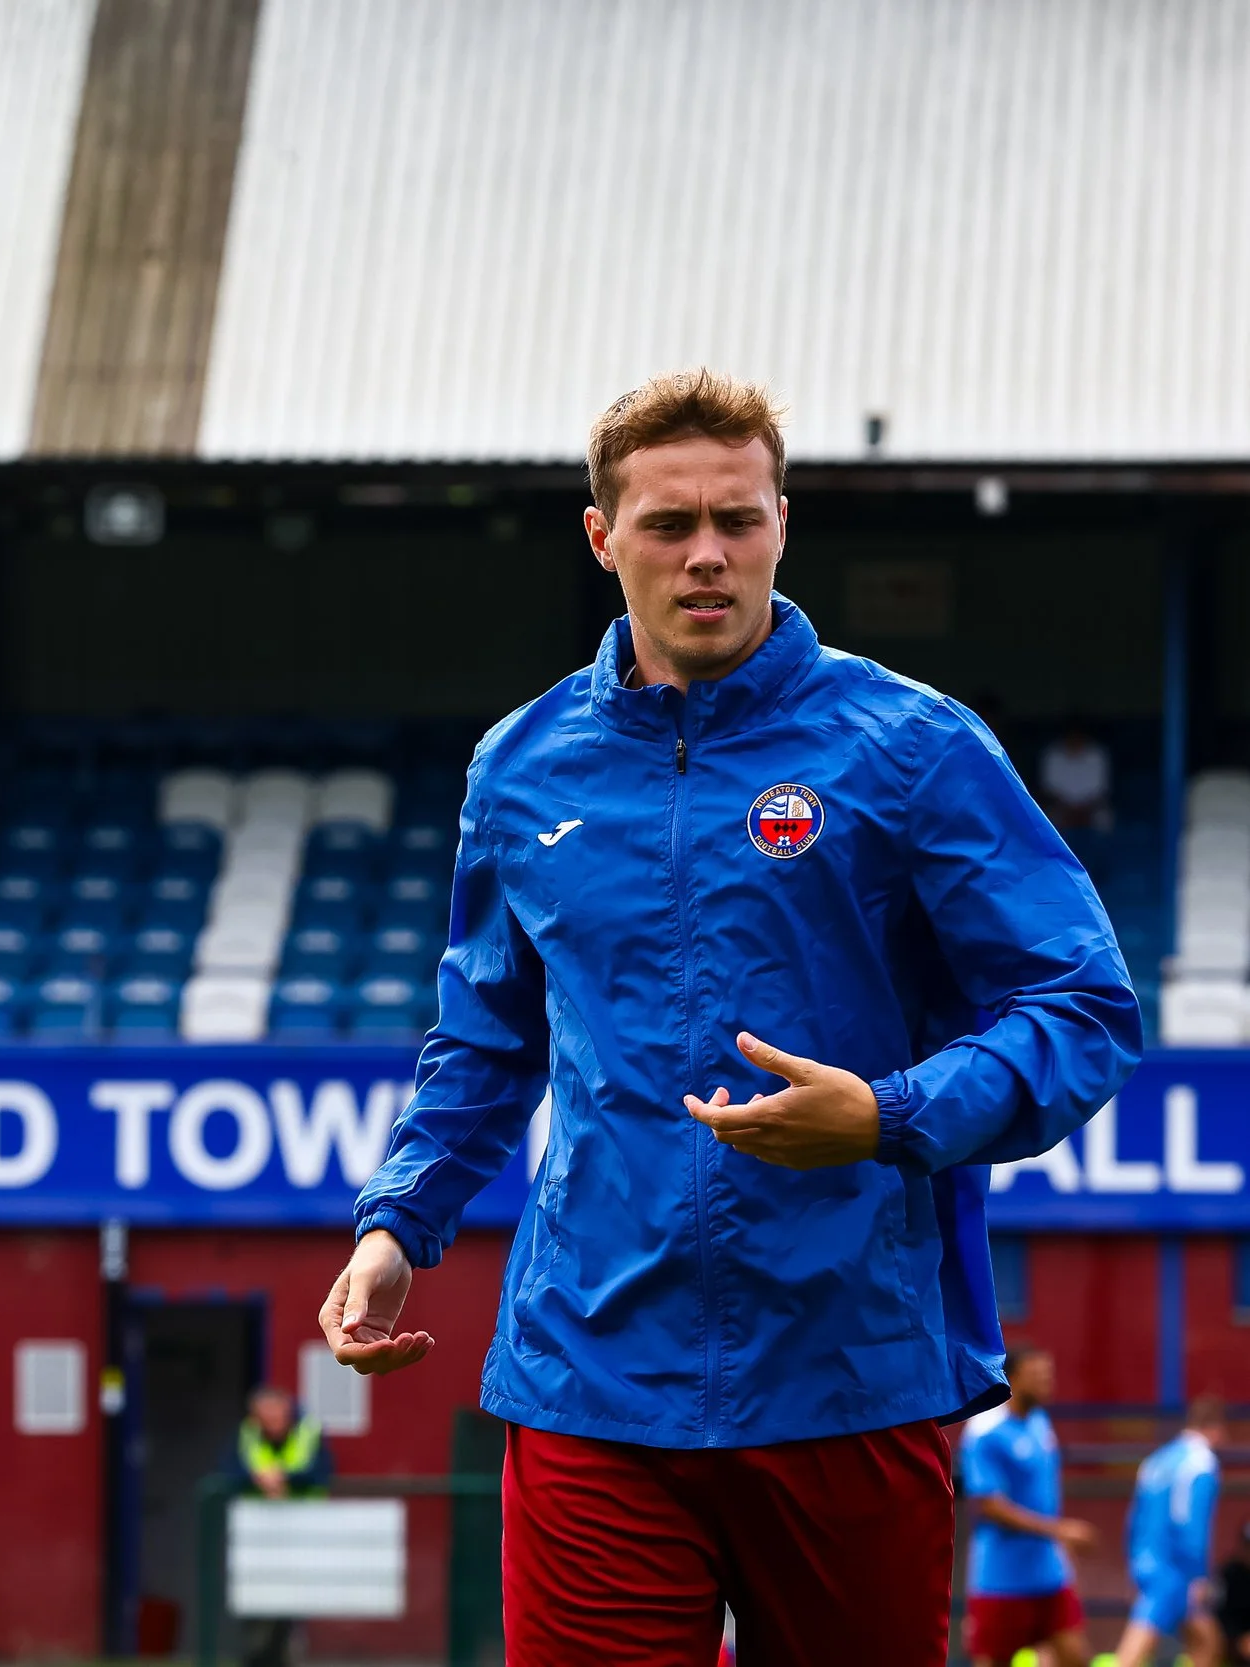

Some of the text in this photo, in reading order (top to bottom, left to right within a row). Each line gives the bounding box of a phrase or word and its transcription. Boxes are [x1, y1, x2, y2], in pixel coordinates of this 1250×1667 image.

[754, 786, 818, 810] NUNEATON TOWN
[754, 833, 815, 855] FOOTBALL CLUB
[91, 1080, 415, 1189] TOW
